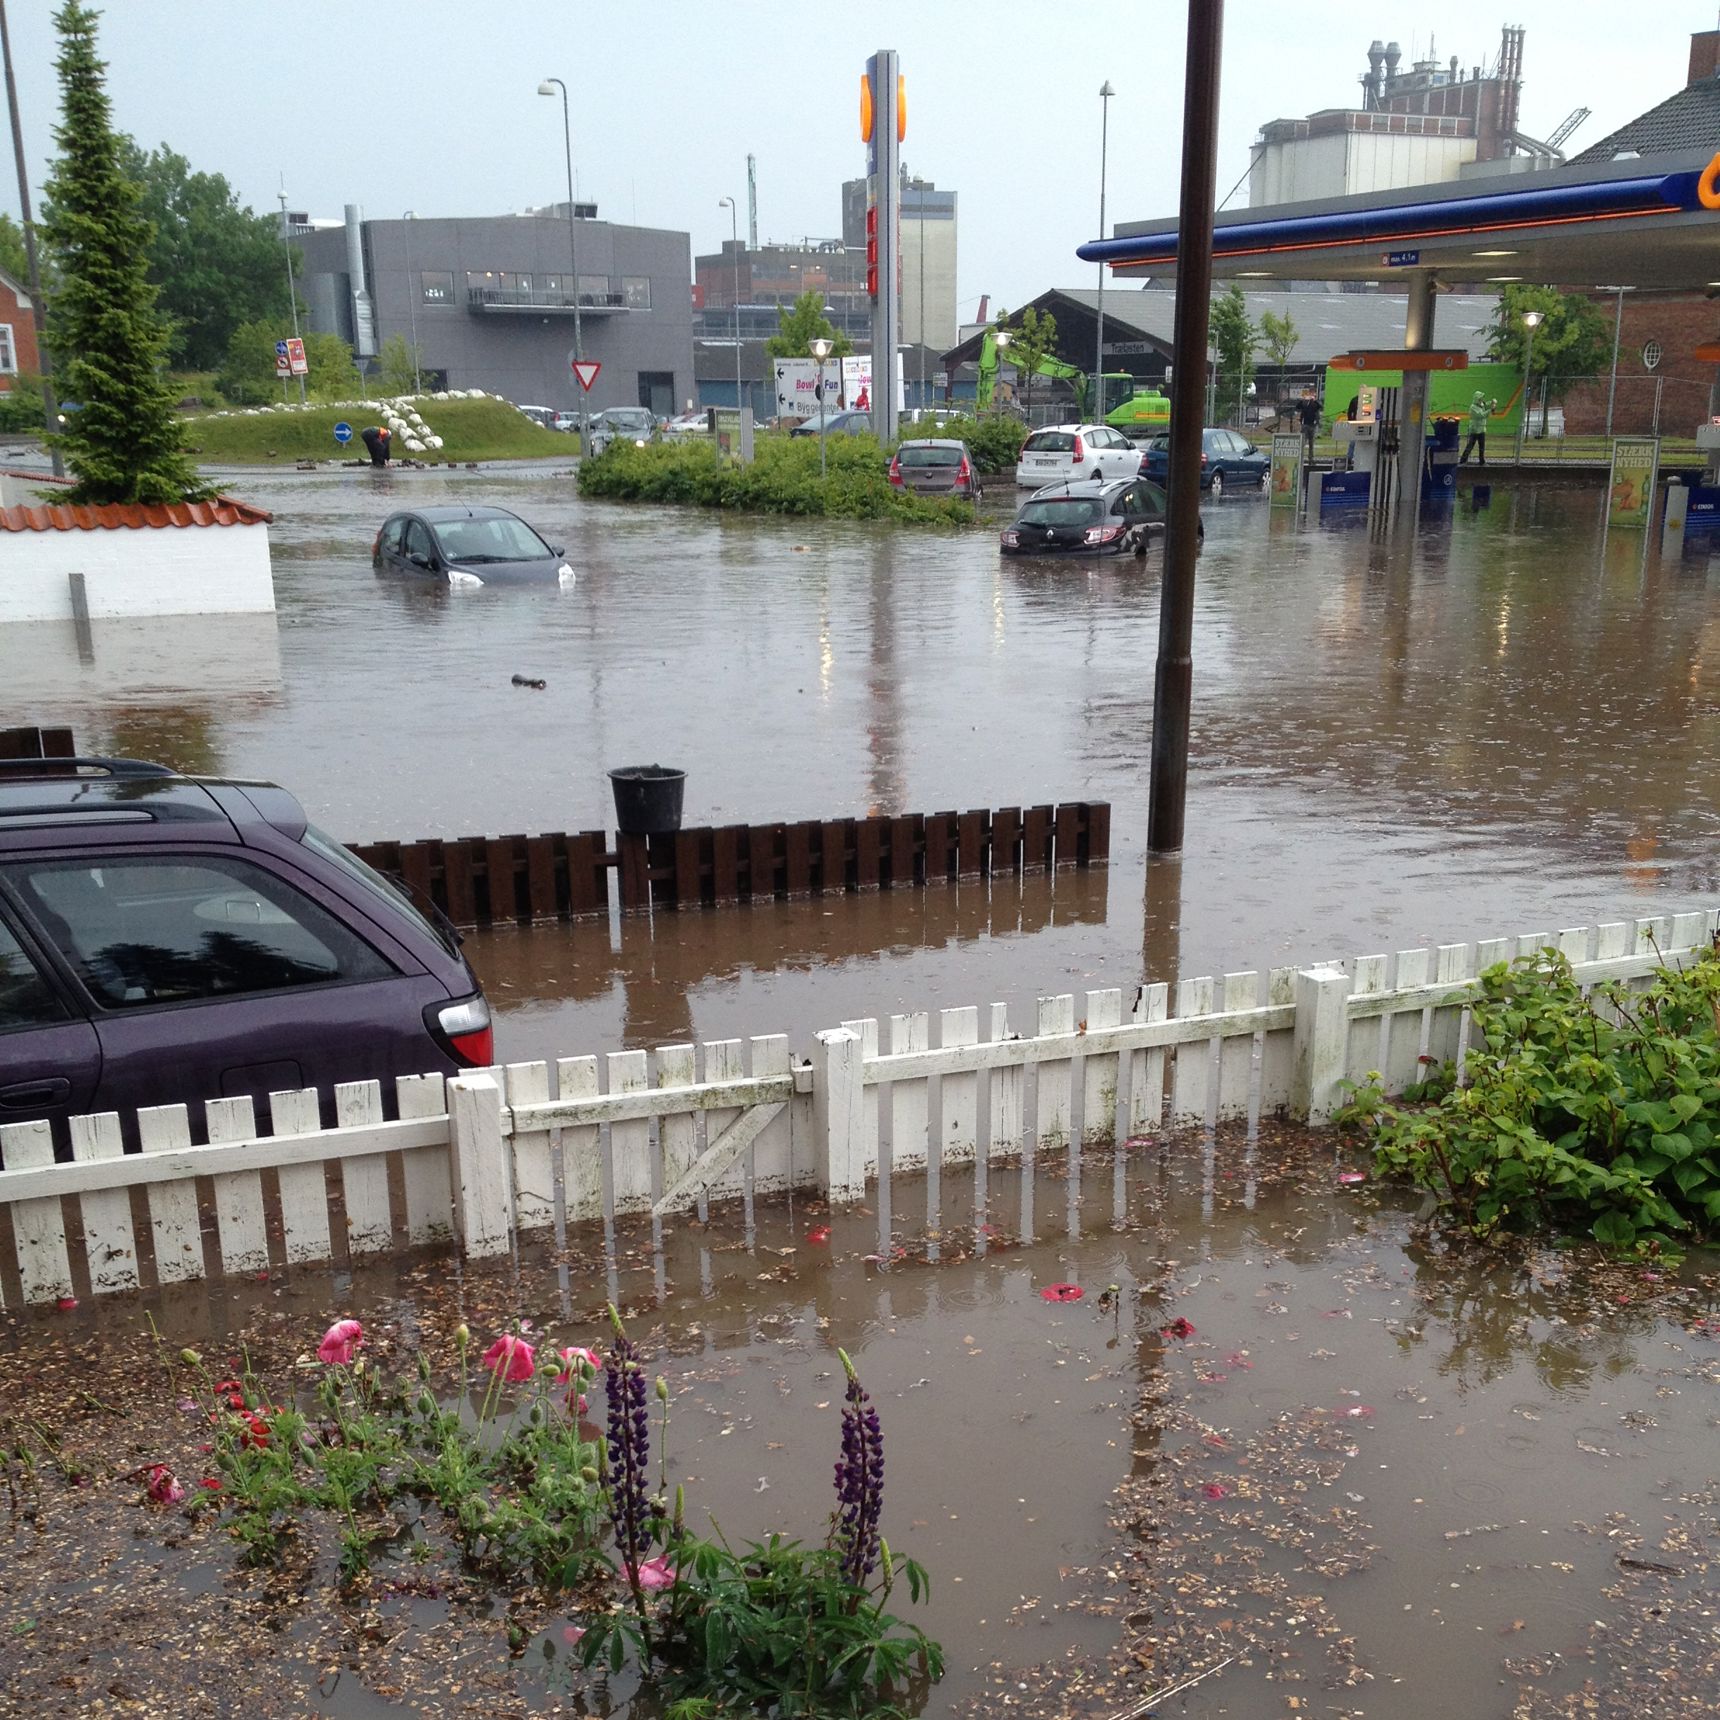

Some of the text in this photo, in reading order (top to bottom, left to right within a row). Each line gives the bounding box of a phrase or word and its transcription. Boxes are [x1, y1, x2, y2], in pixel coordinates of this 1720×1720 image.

[796, 379, 815, 389] Bowl
[824, 379, 839, 389] Fun
[797, 402, 839, 414] Byggeenter
[1274, 448, 1299, 457] NYHED
[1616, 445, 1654, 457] STÆRK
[1615, 457, 1652, 468] NYHED
